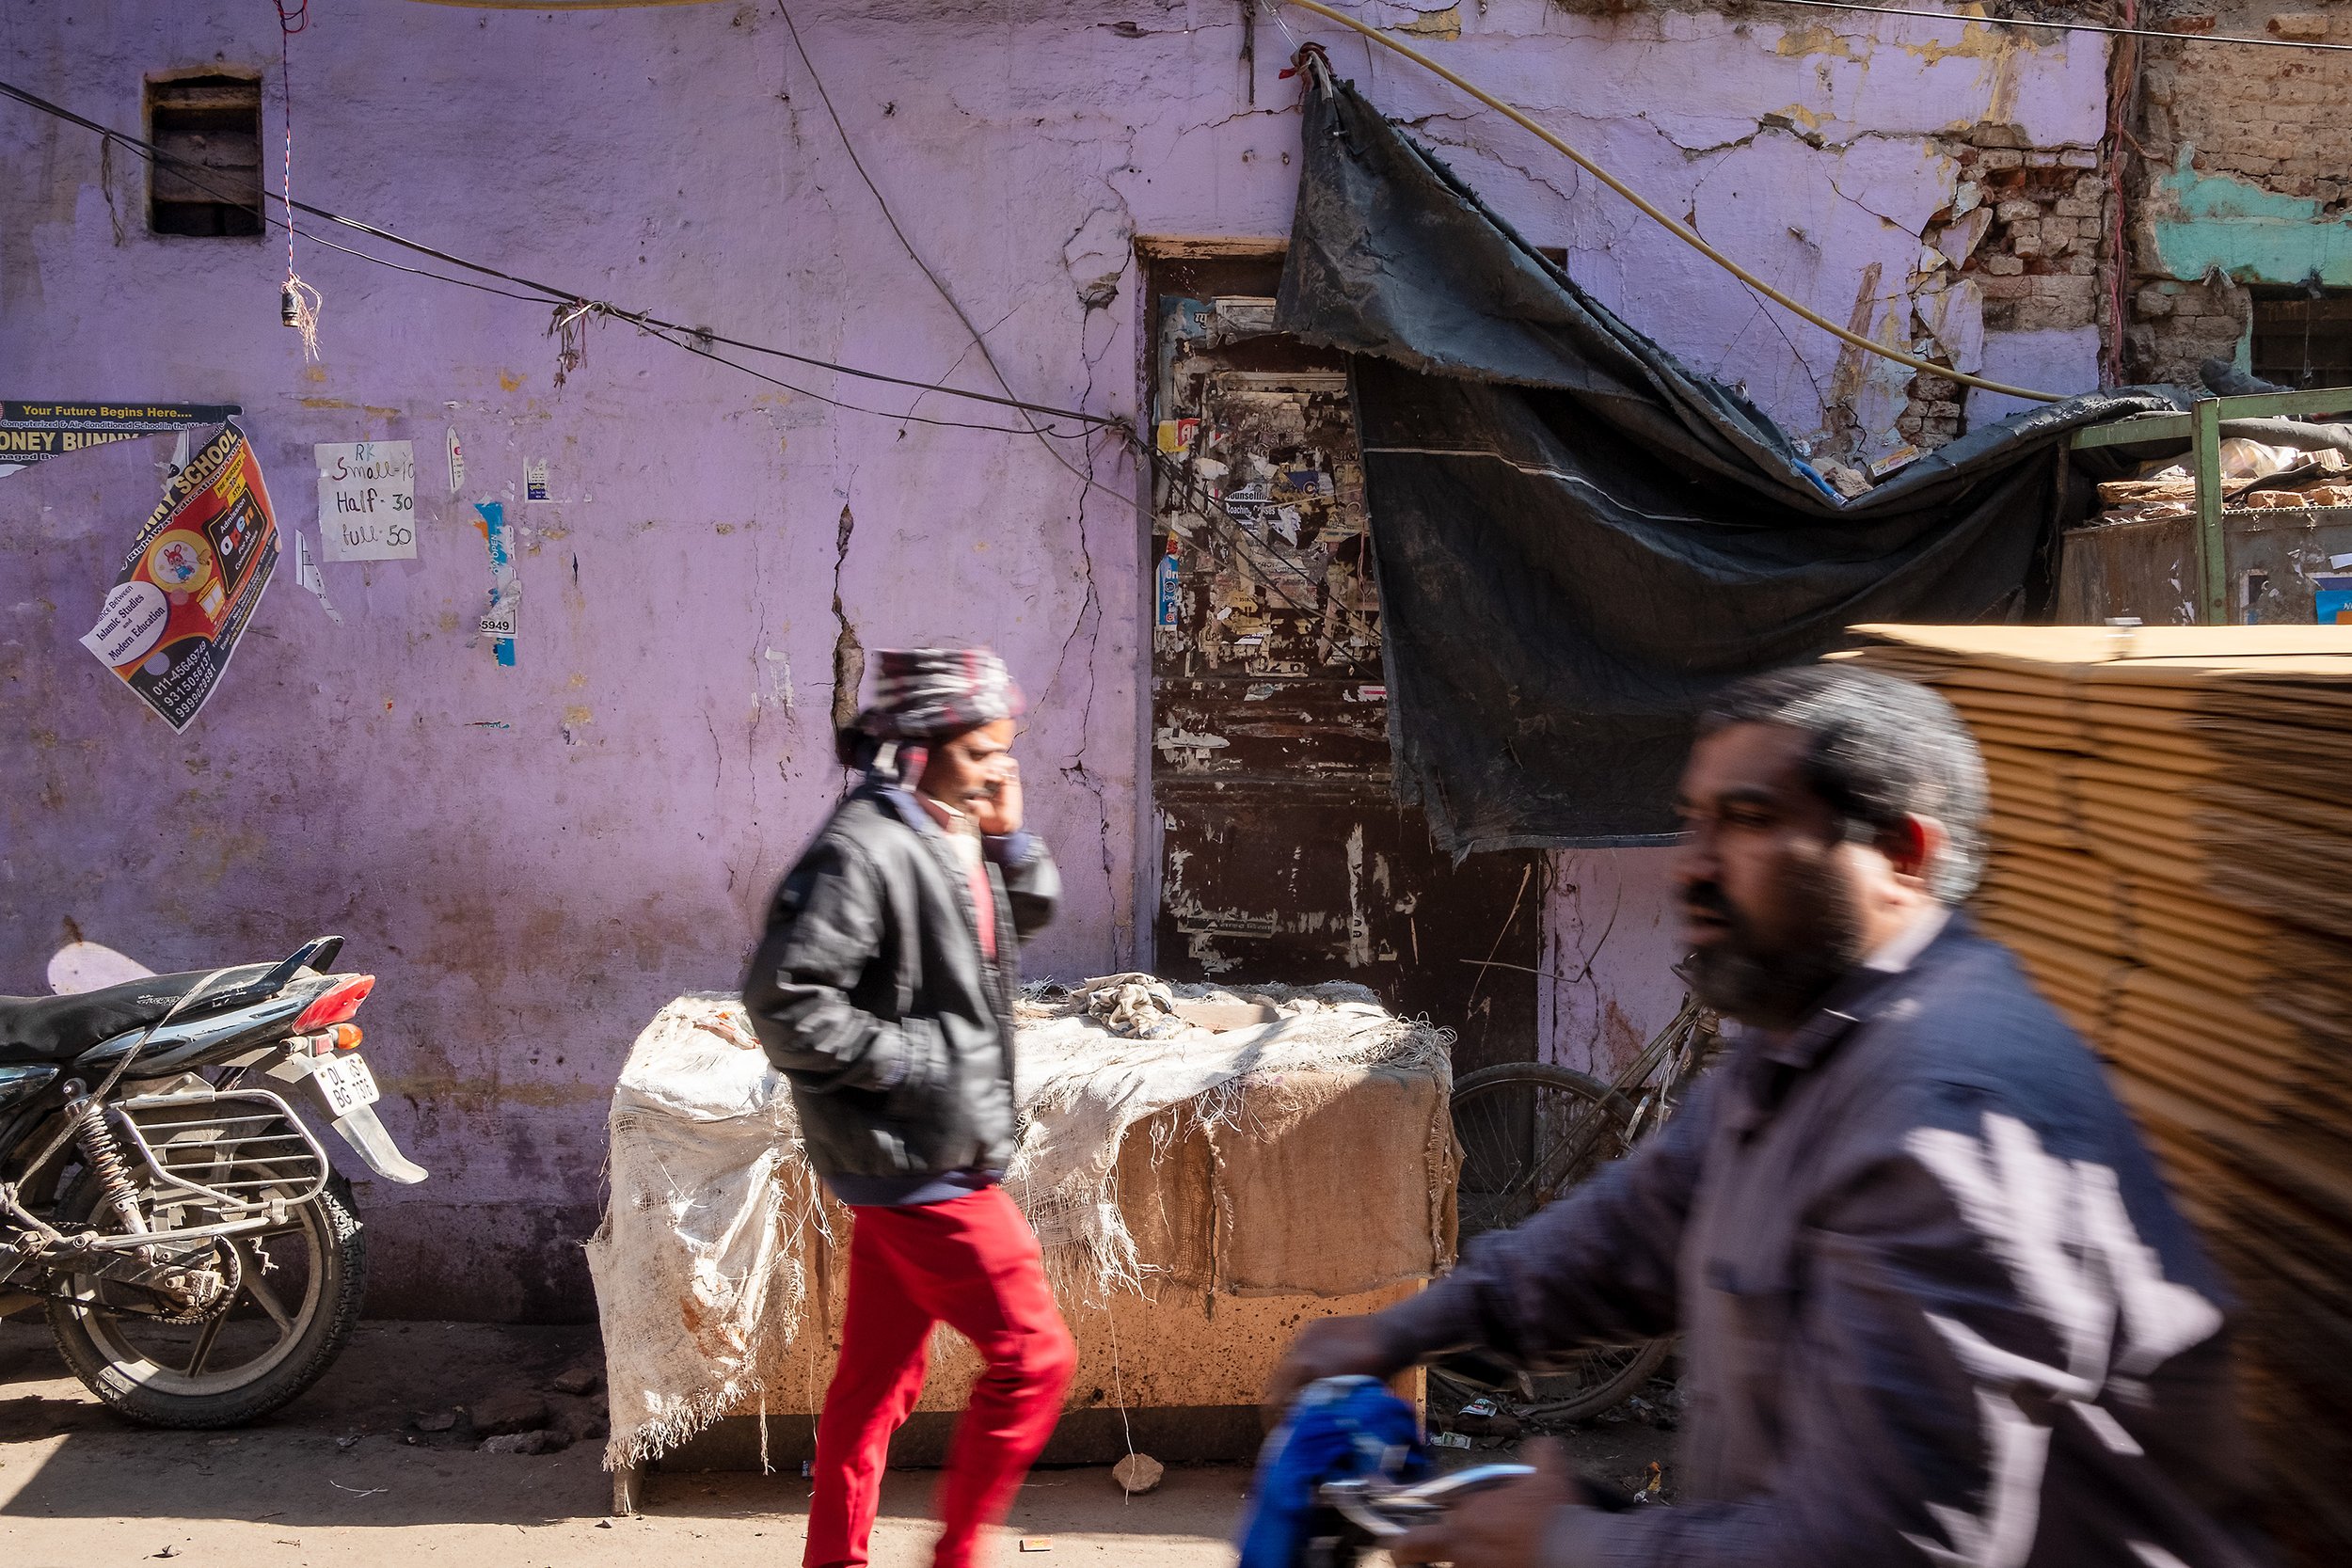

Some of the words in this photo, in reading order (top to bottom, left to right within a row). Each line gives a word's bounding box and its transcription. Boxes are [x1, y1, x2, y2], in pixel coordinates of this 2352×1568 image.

[23, 405, 52, 415] Your
[56, 406, 97, 416] Future
[100, 406, 144, 419] Begins
[134, 421, 163, 430] School
[174, 429, 237, 495] SCHOOL
[172, 462, 227, 516] Educational
[337, 487, 378, 514] Half
[392, 493, 413, 511] 30
[219, 498, 246, 534] Admission
[387, 524, 412, 546] 50
[108, 584, 134, 610] Between
[96, 617, 120, 641] Islamic
[118, 594, 145, 619] Studies
[122, 618, 133, 629] and
[480, 620, 510, 631] 5949
[107, 636, 135, 660] Modern
[131, 606, 166, 638] Education
[152, 641, 206, 695] 011-45649749
[164, 651, 211, 706] 9315056137
[176, 663, 215, 717] 9999029591
[326, 1066, 345, 1086] DL
[332, 1086, 352, 1109] BG
